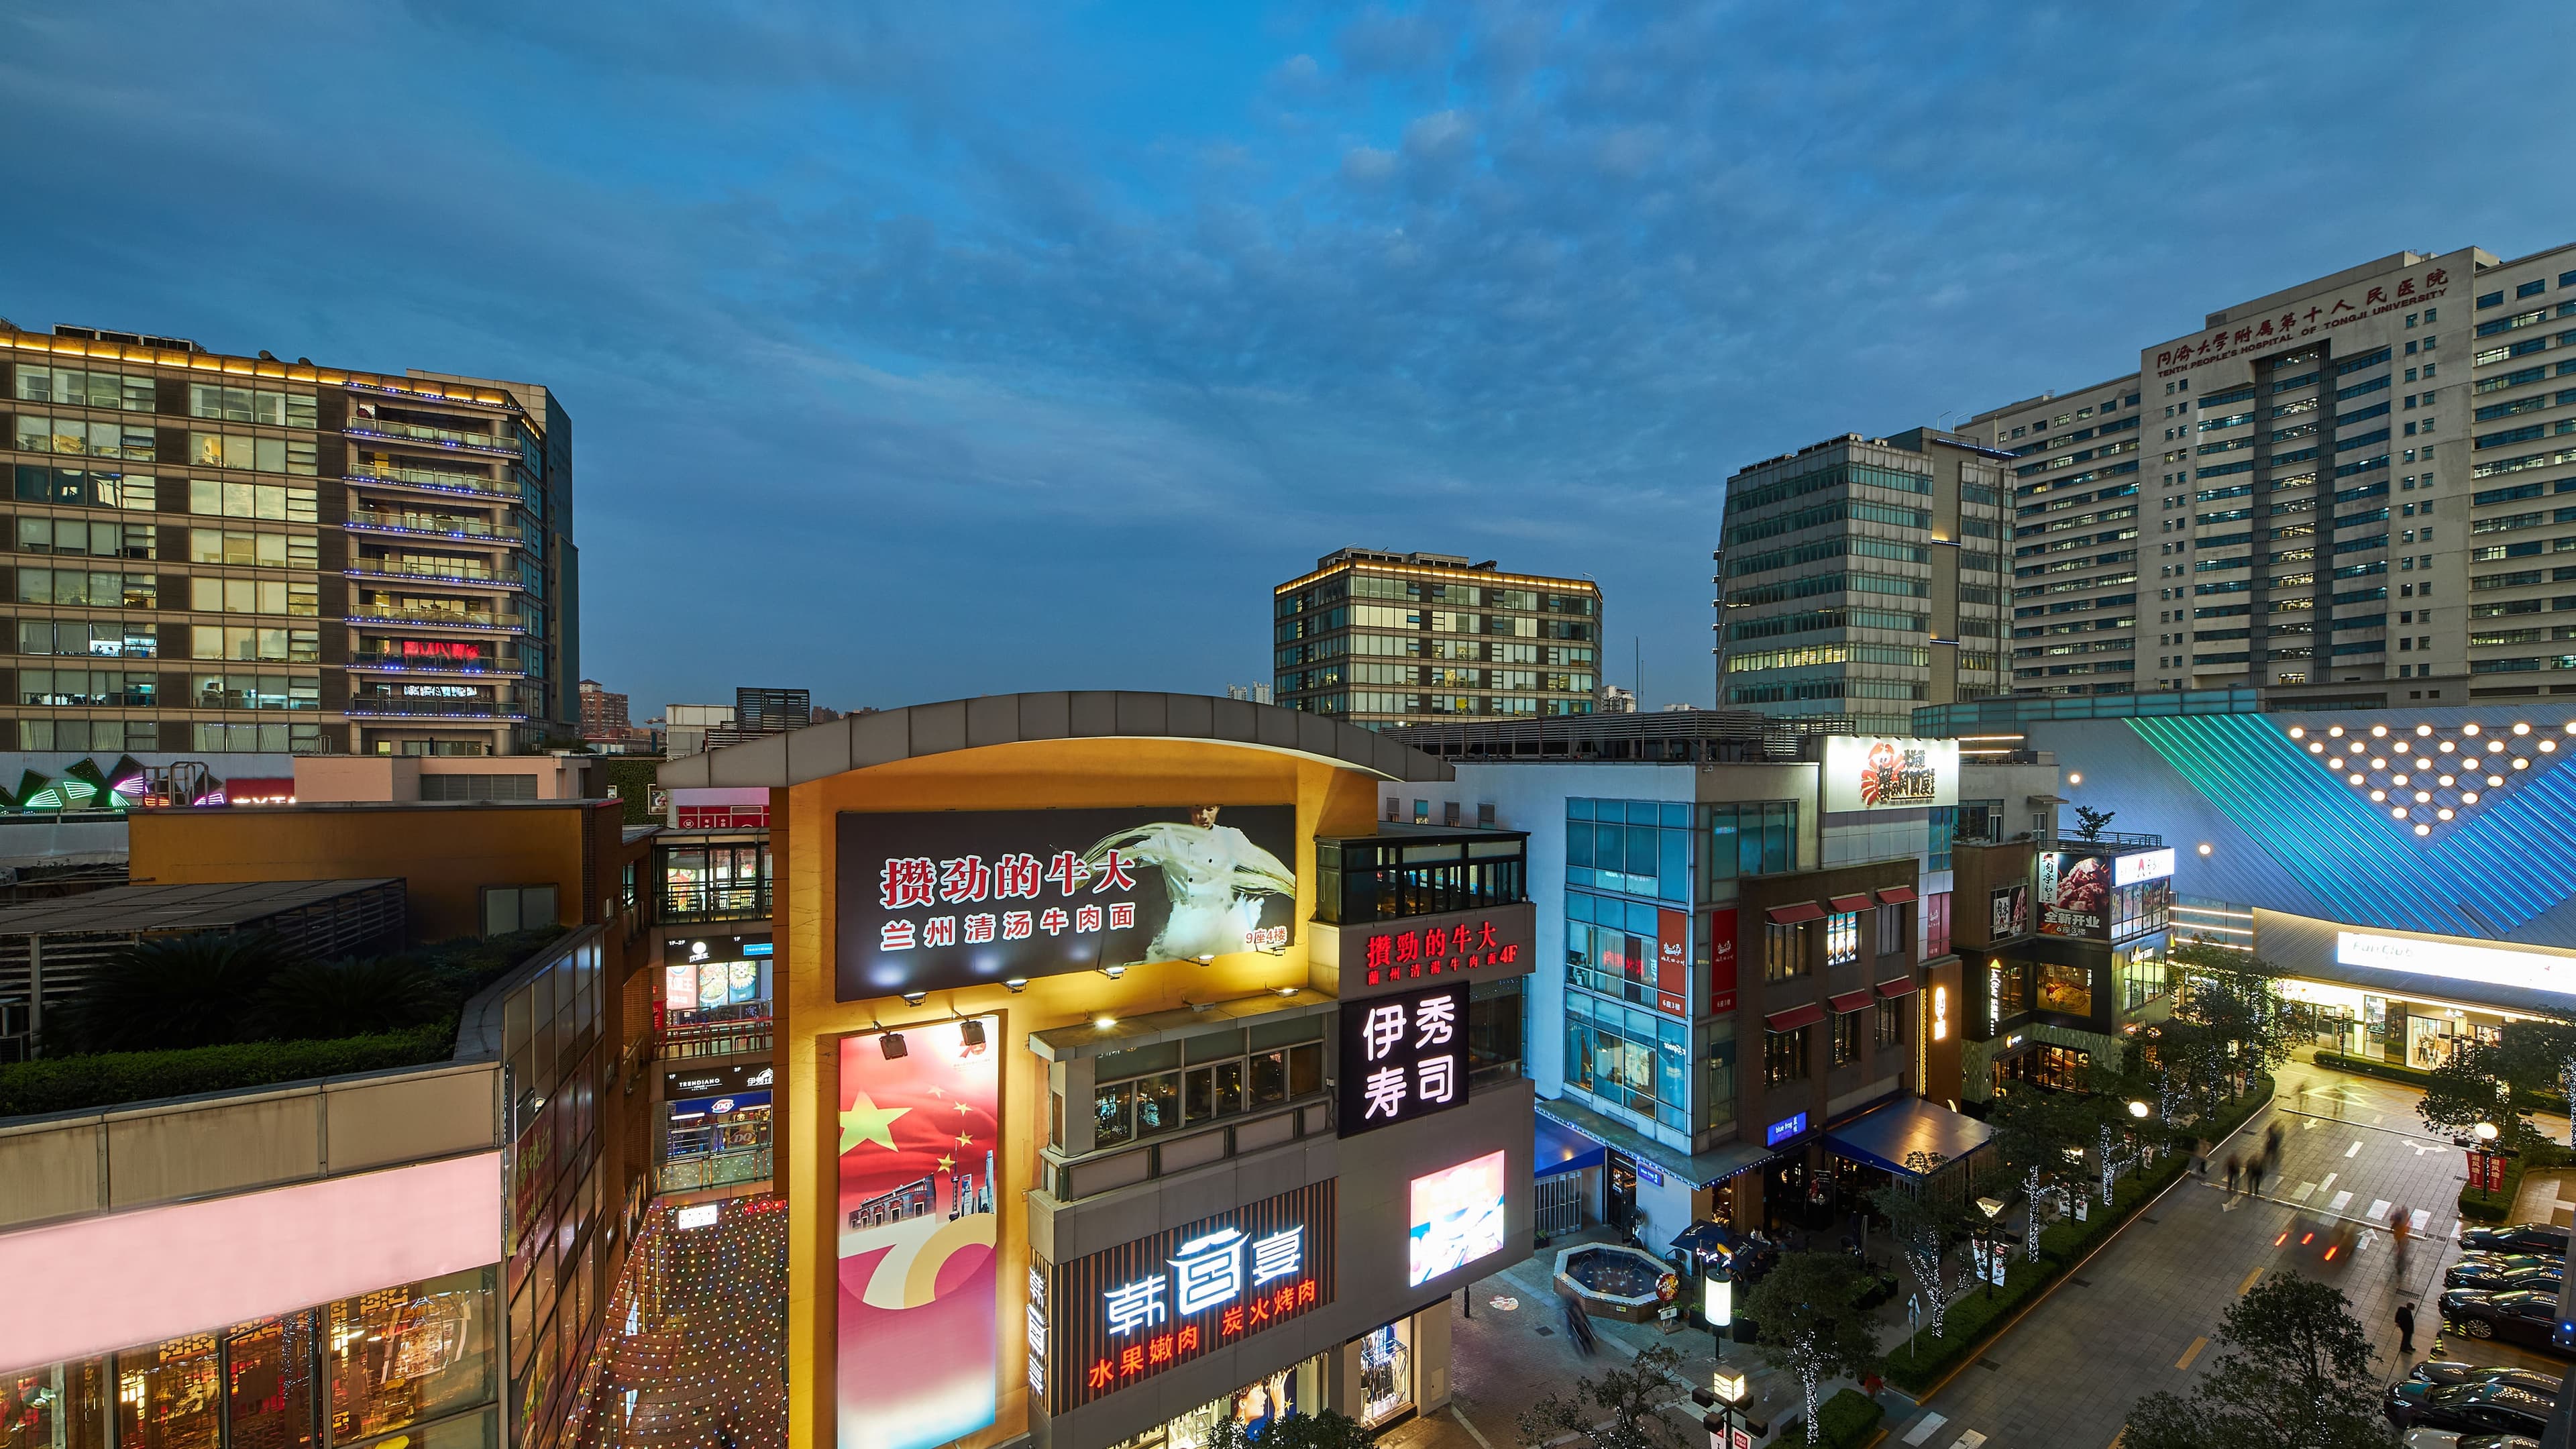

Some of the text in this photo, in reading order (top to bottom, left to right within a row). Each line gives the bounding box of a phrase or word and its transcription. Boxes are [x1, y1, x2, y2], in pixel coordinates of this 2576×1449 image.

[2158, 288, 2447, 378] TENTH PEOPLE'S HOSPITAL OF TONGJI UNIVERSITY
[880, 849, 1136, 910] 攒劲的牛大
[879, 902, 1136, 951] 兰州清汤牛肉面
[1245, 926, 1287, 945] 9座4楼
[2044, 911, 2100, 928] 全新开业
[1499, 945, 1519, 964] 4F
[1362, 994, 1455, 1062] 伊秀
[679, 1078, 720, 1087] TRENDIANO
[1364, 1053, 1454, 1120] 寿司
[734, 1132, 753, 1143] DQ
[1776, 1122, 1792, 1133] blue frog
[1088, 1279, 1316, 1389] 水果嫩肉 炭火烤肉
